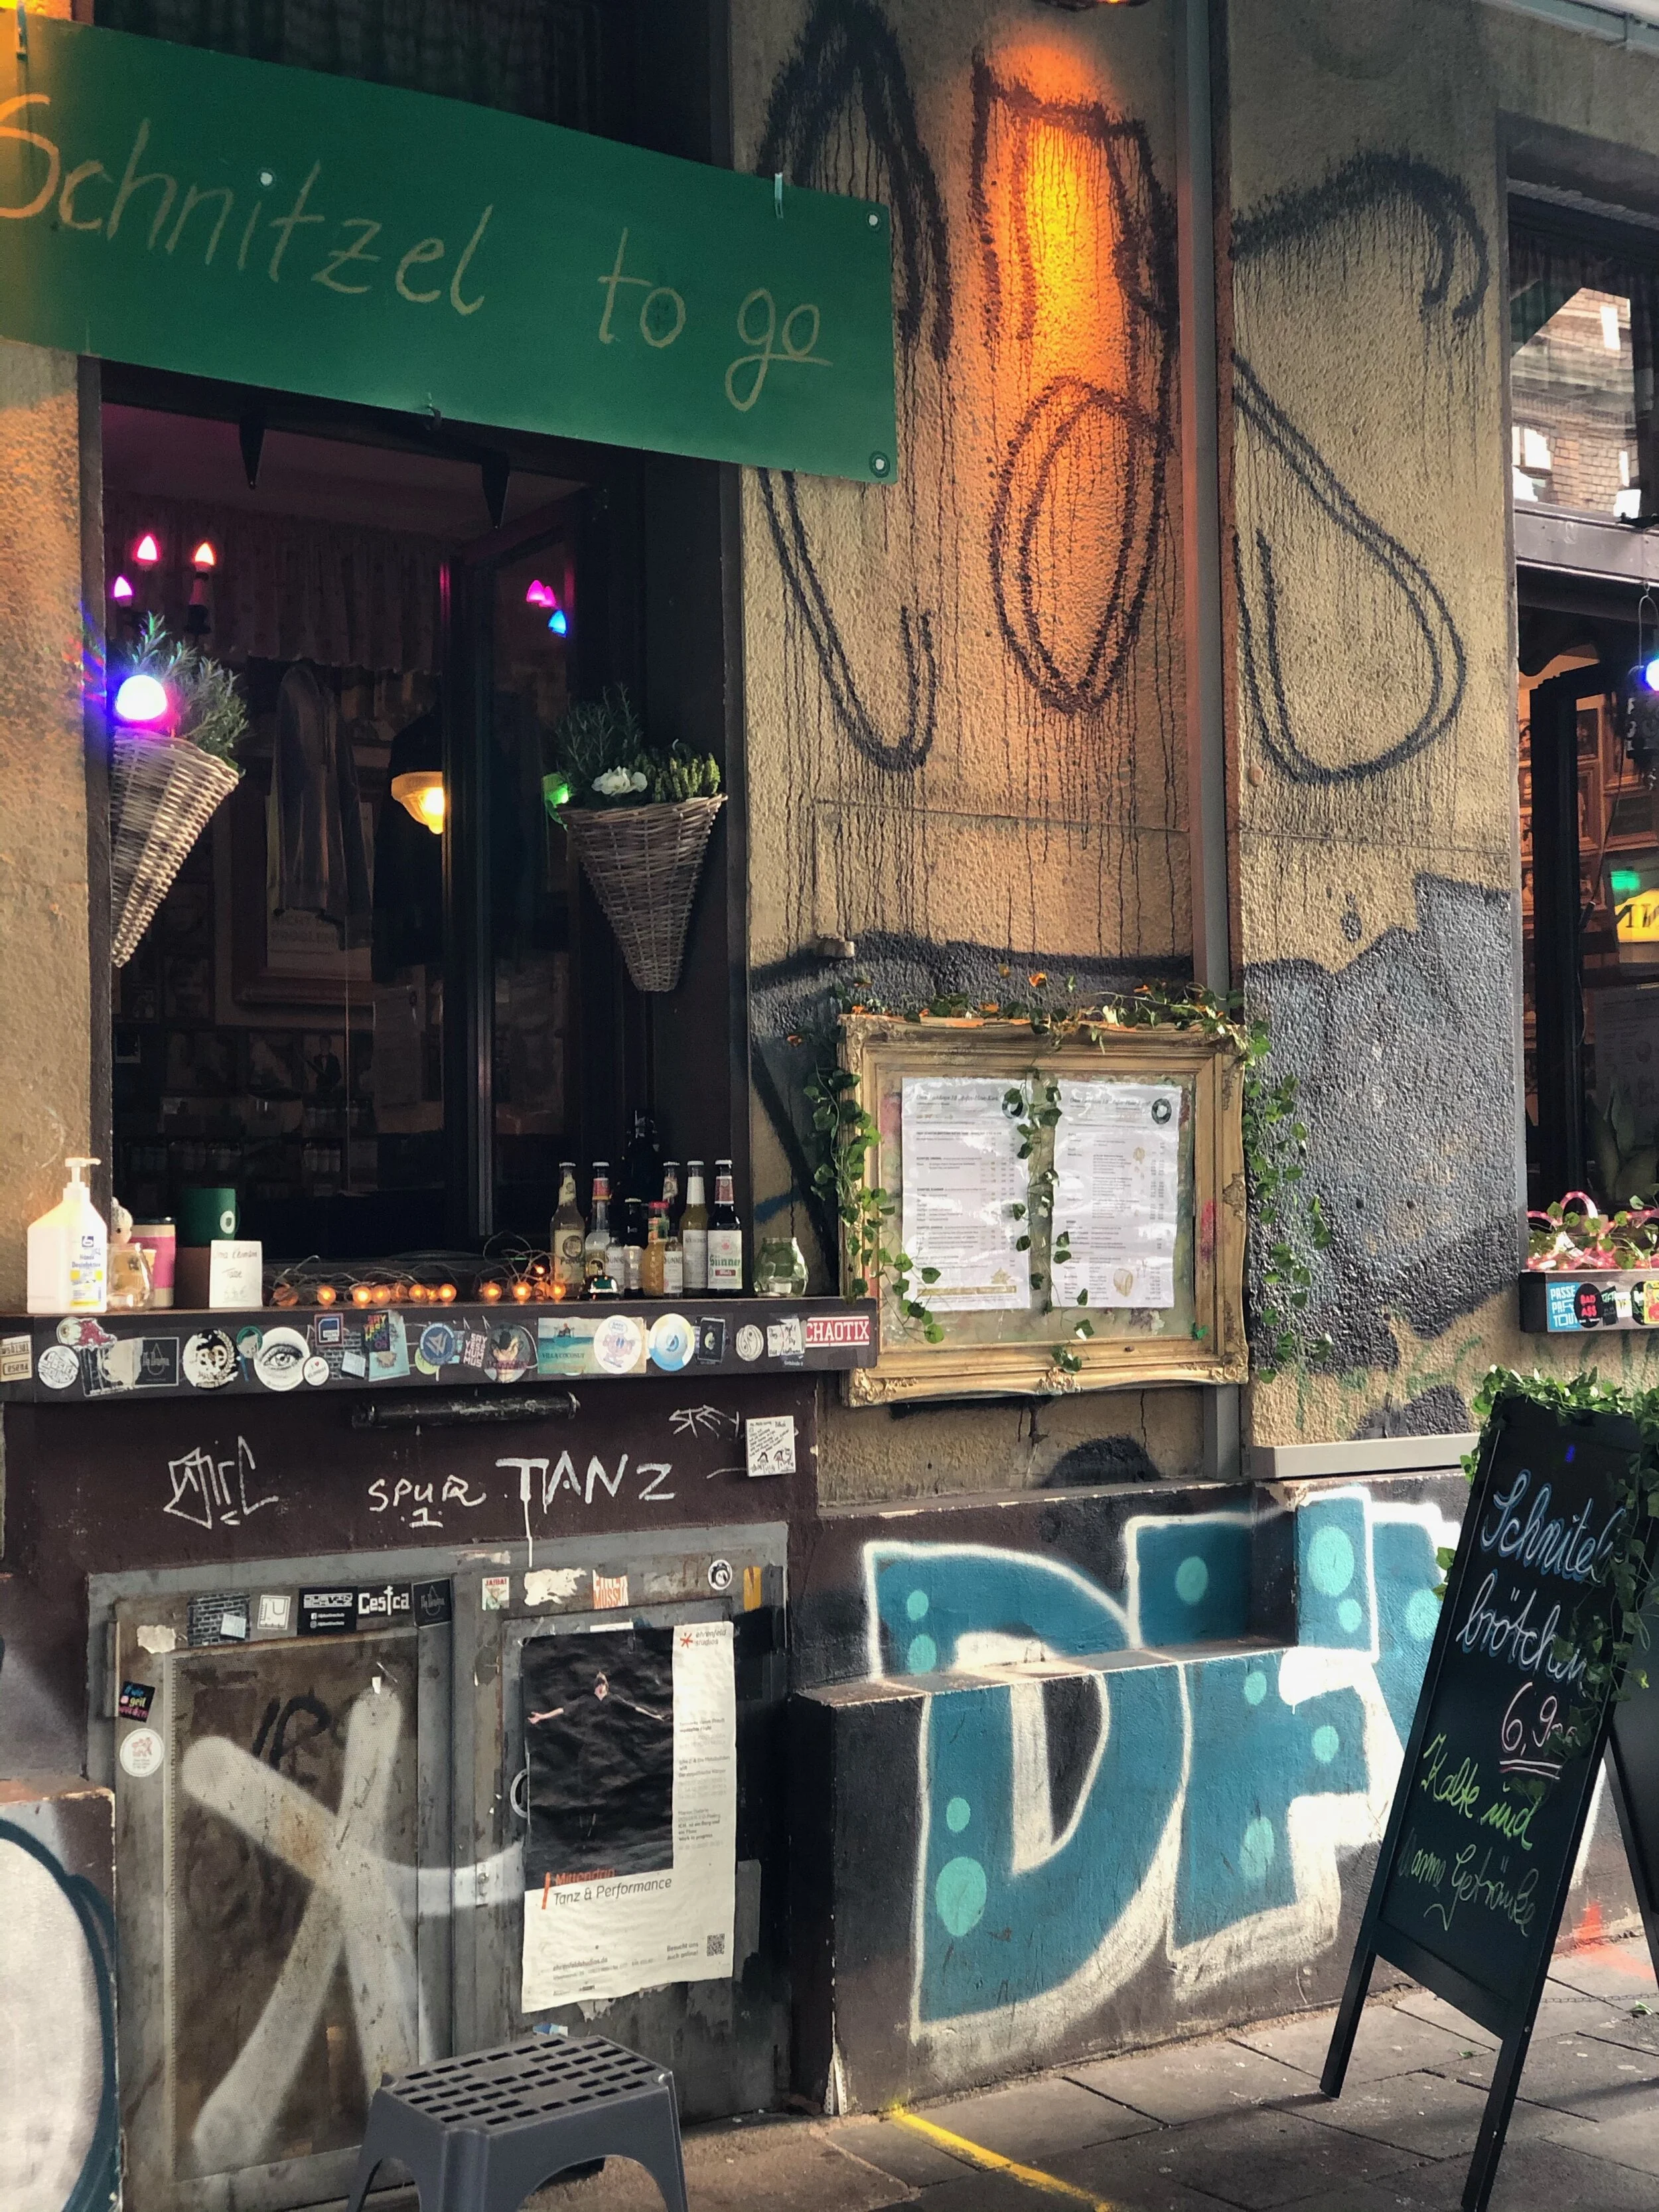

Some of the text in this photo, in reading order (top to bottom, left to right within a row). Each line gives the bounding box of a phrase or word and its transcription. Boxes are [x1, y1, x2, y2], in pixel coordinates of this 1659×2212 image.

[0, 93, 833, 411] Schnitzel to go
[1550, 1286, 1575, 1301] PASSE
[1580, 1295, 1596, 1305] BAD
[1581, 1305, 1597, 1317] ASS
[470, 1333, 488, 1343] SAY
[806, 1320, 869, 1342] CHAOTIX
[463, 1356, 482, 1368] MUS
[368, 1451, 677, 1514] SPUR TANZ
[695, 1629, 727, 1638] ehrenfeld
[1421, 1733, 1544, 1851] Kalte und
[555, 1868, 616, 1885] Mittendrin
[553, 1878, 672, 1905] Tanz & Performance
